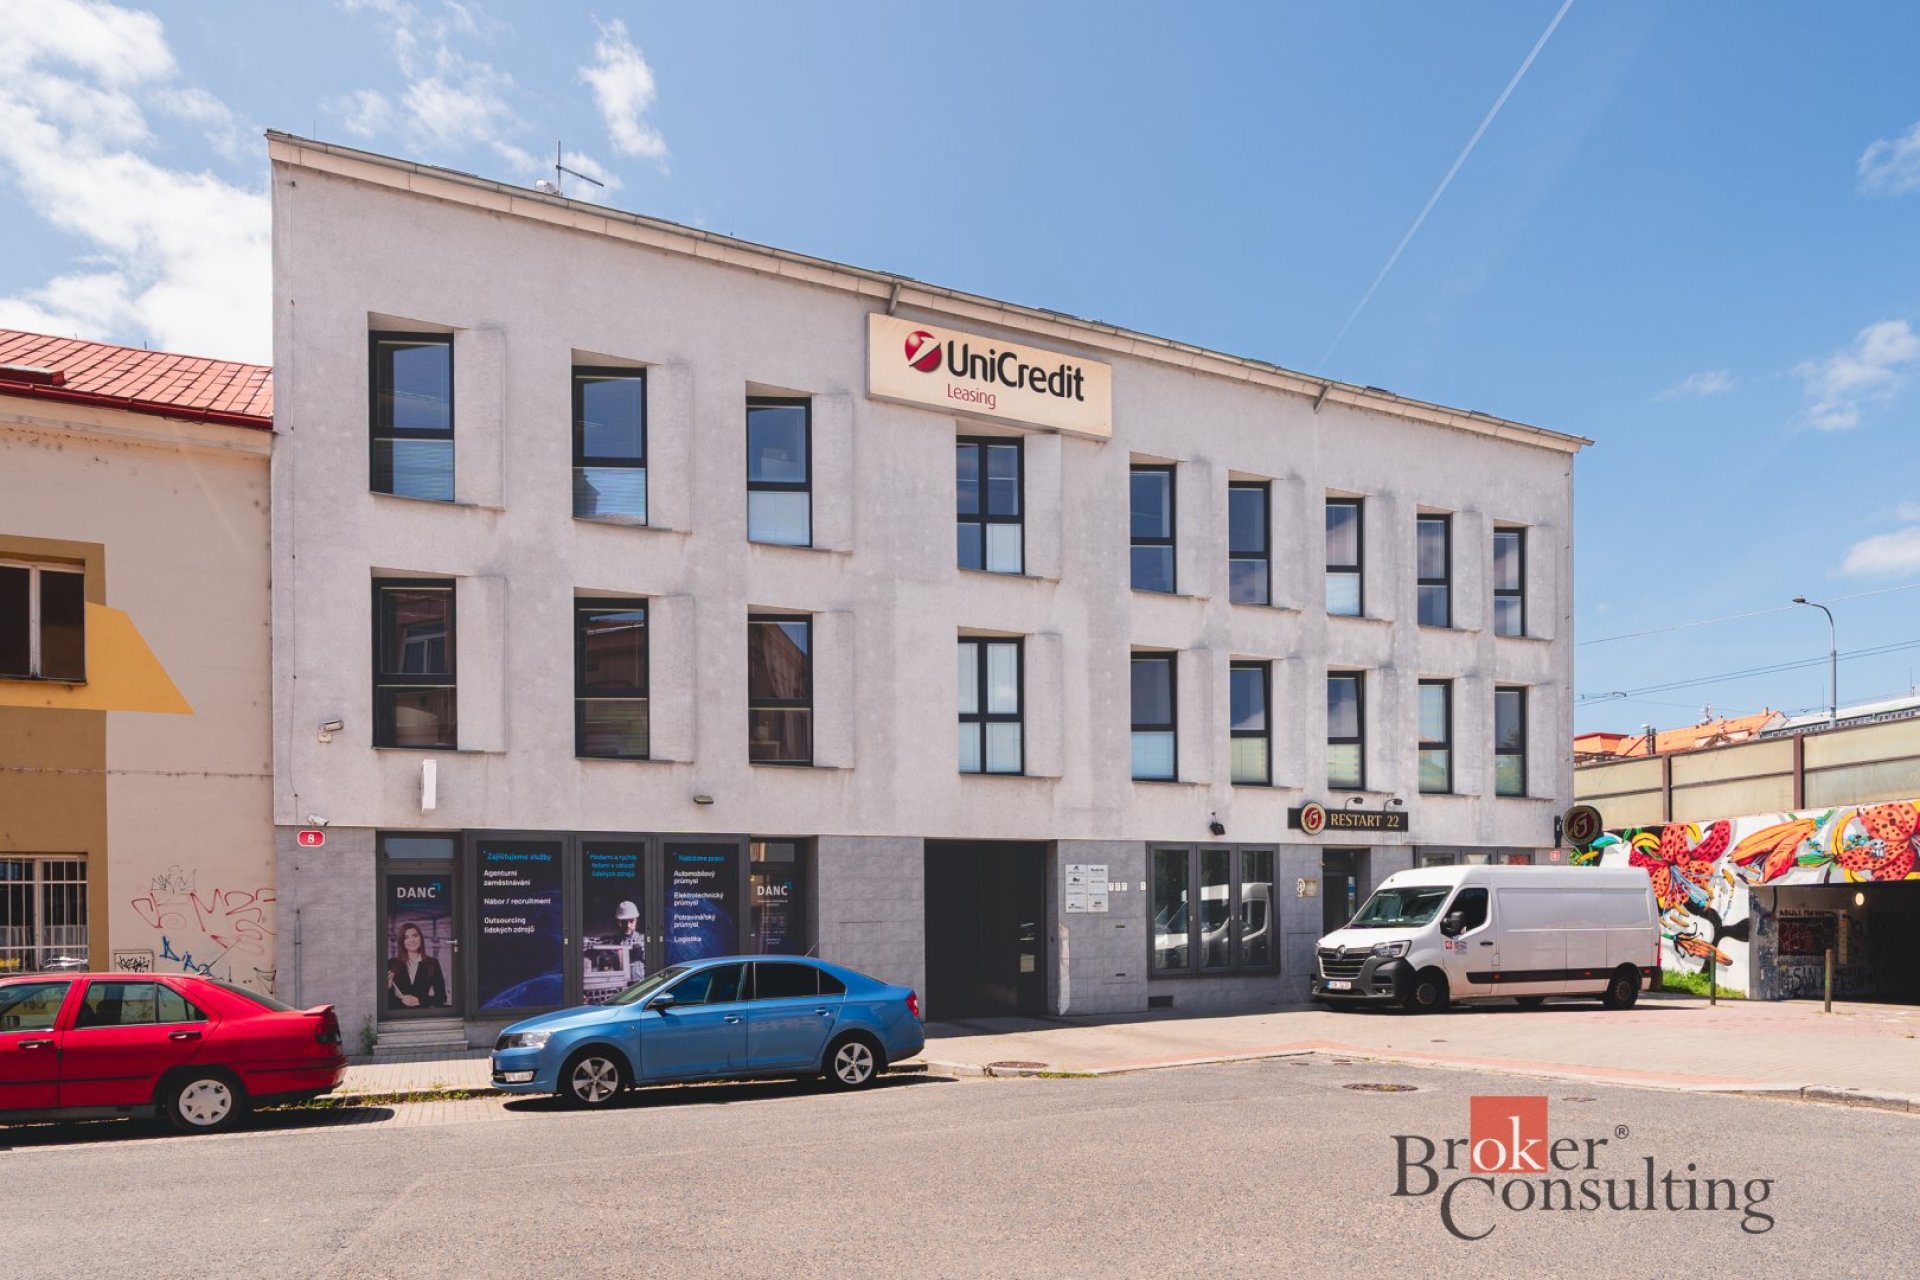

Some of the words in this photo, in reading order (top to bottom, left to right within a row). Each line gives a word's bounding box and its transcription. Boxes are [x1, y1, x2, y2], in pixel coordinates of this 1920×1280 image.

[947, 340, 1085, 402] UniCredit
[947, 383, 996, 410] Leasing
[1330, 813, 1382, 827] RESTART
[1387, 815, 1400, 828] 22
[307, 833, 315, 844] 8
[674, 878, 699, 886] průmysl
[396, 887, 436, 898] DANC
[757, 885, 788, 896] DANC
[511, 897, 551, 905] recruitment
[674, 899, 699, 908] průmysl
[484, 917, 526, 925] Outsourcing
[674, 921, 699, 929] průmysl
[674, 936, 702, 944] Logistika
